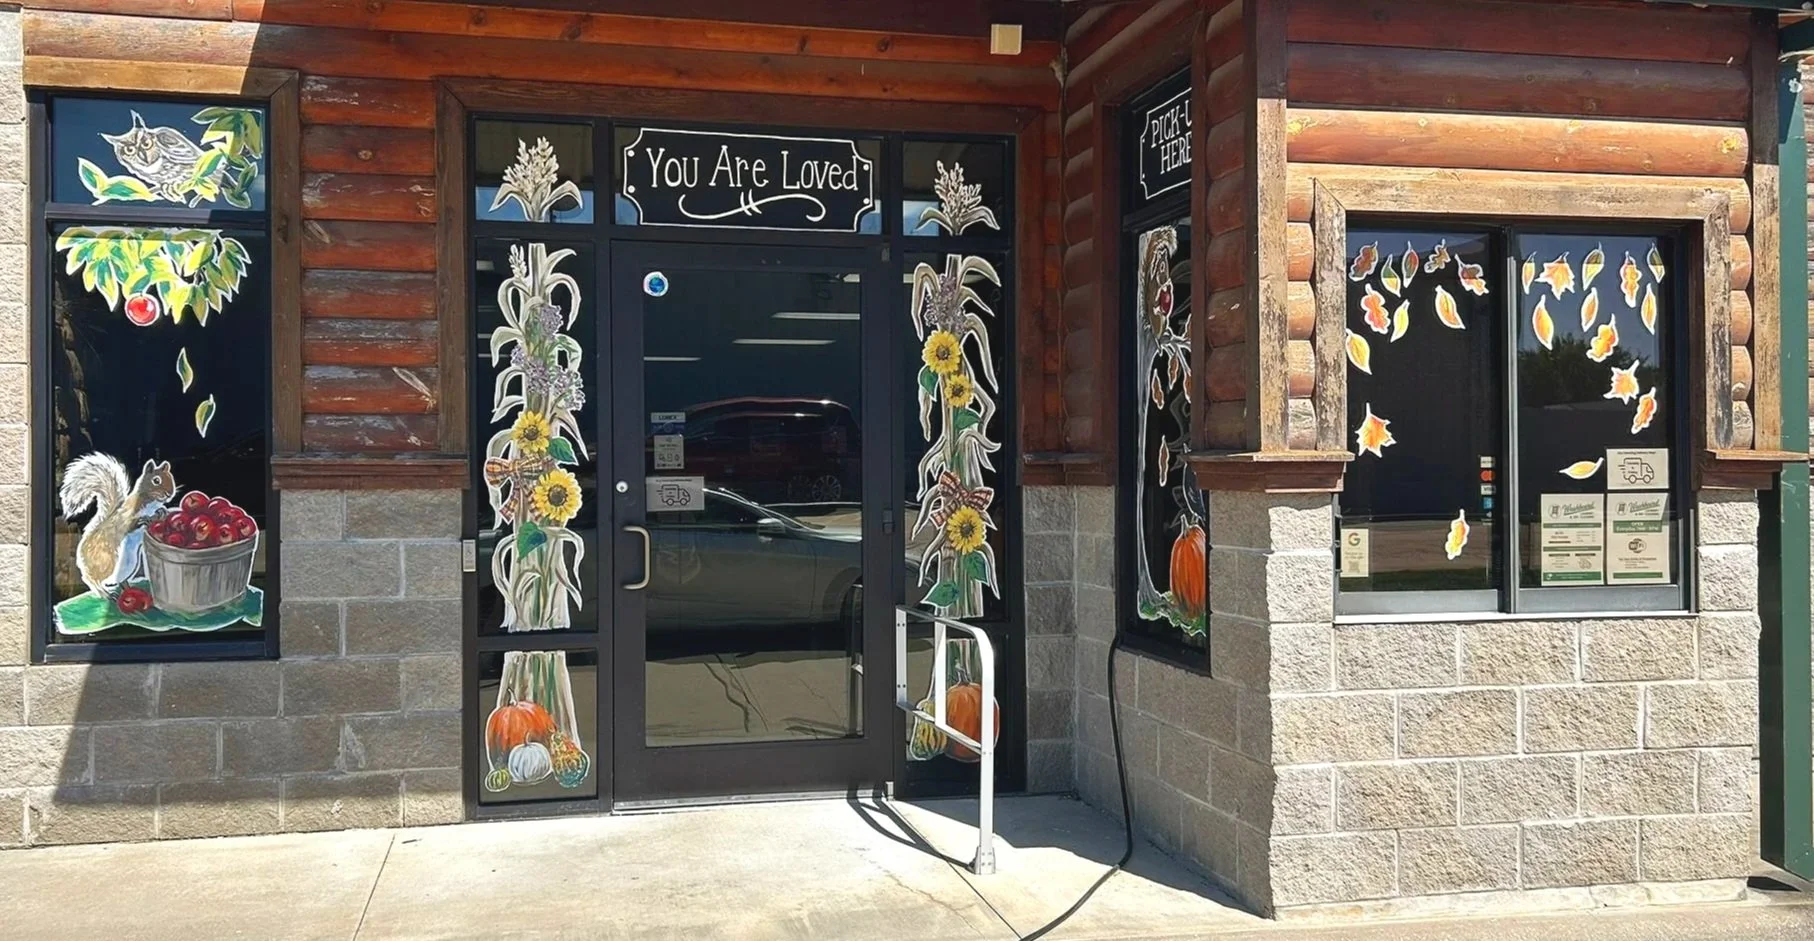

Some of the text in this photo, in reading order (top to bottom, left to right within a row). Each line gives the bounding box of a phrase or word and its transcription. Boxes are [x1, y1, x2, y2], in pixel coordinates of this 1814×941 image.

[1150, 100, 1192, 148] PICK-U
[645, 145, 859, 191] You Are Loved
[1160, 131, 1192, 175] HERE
